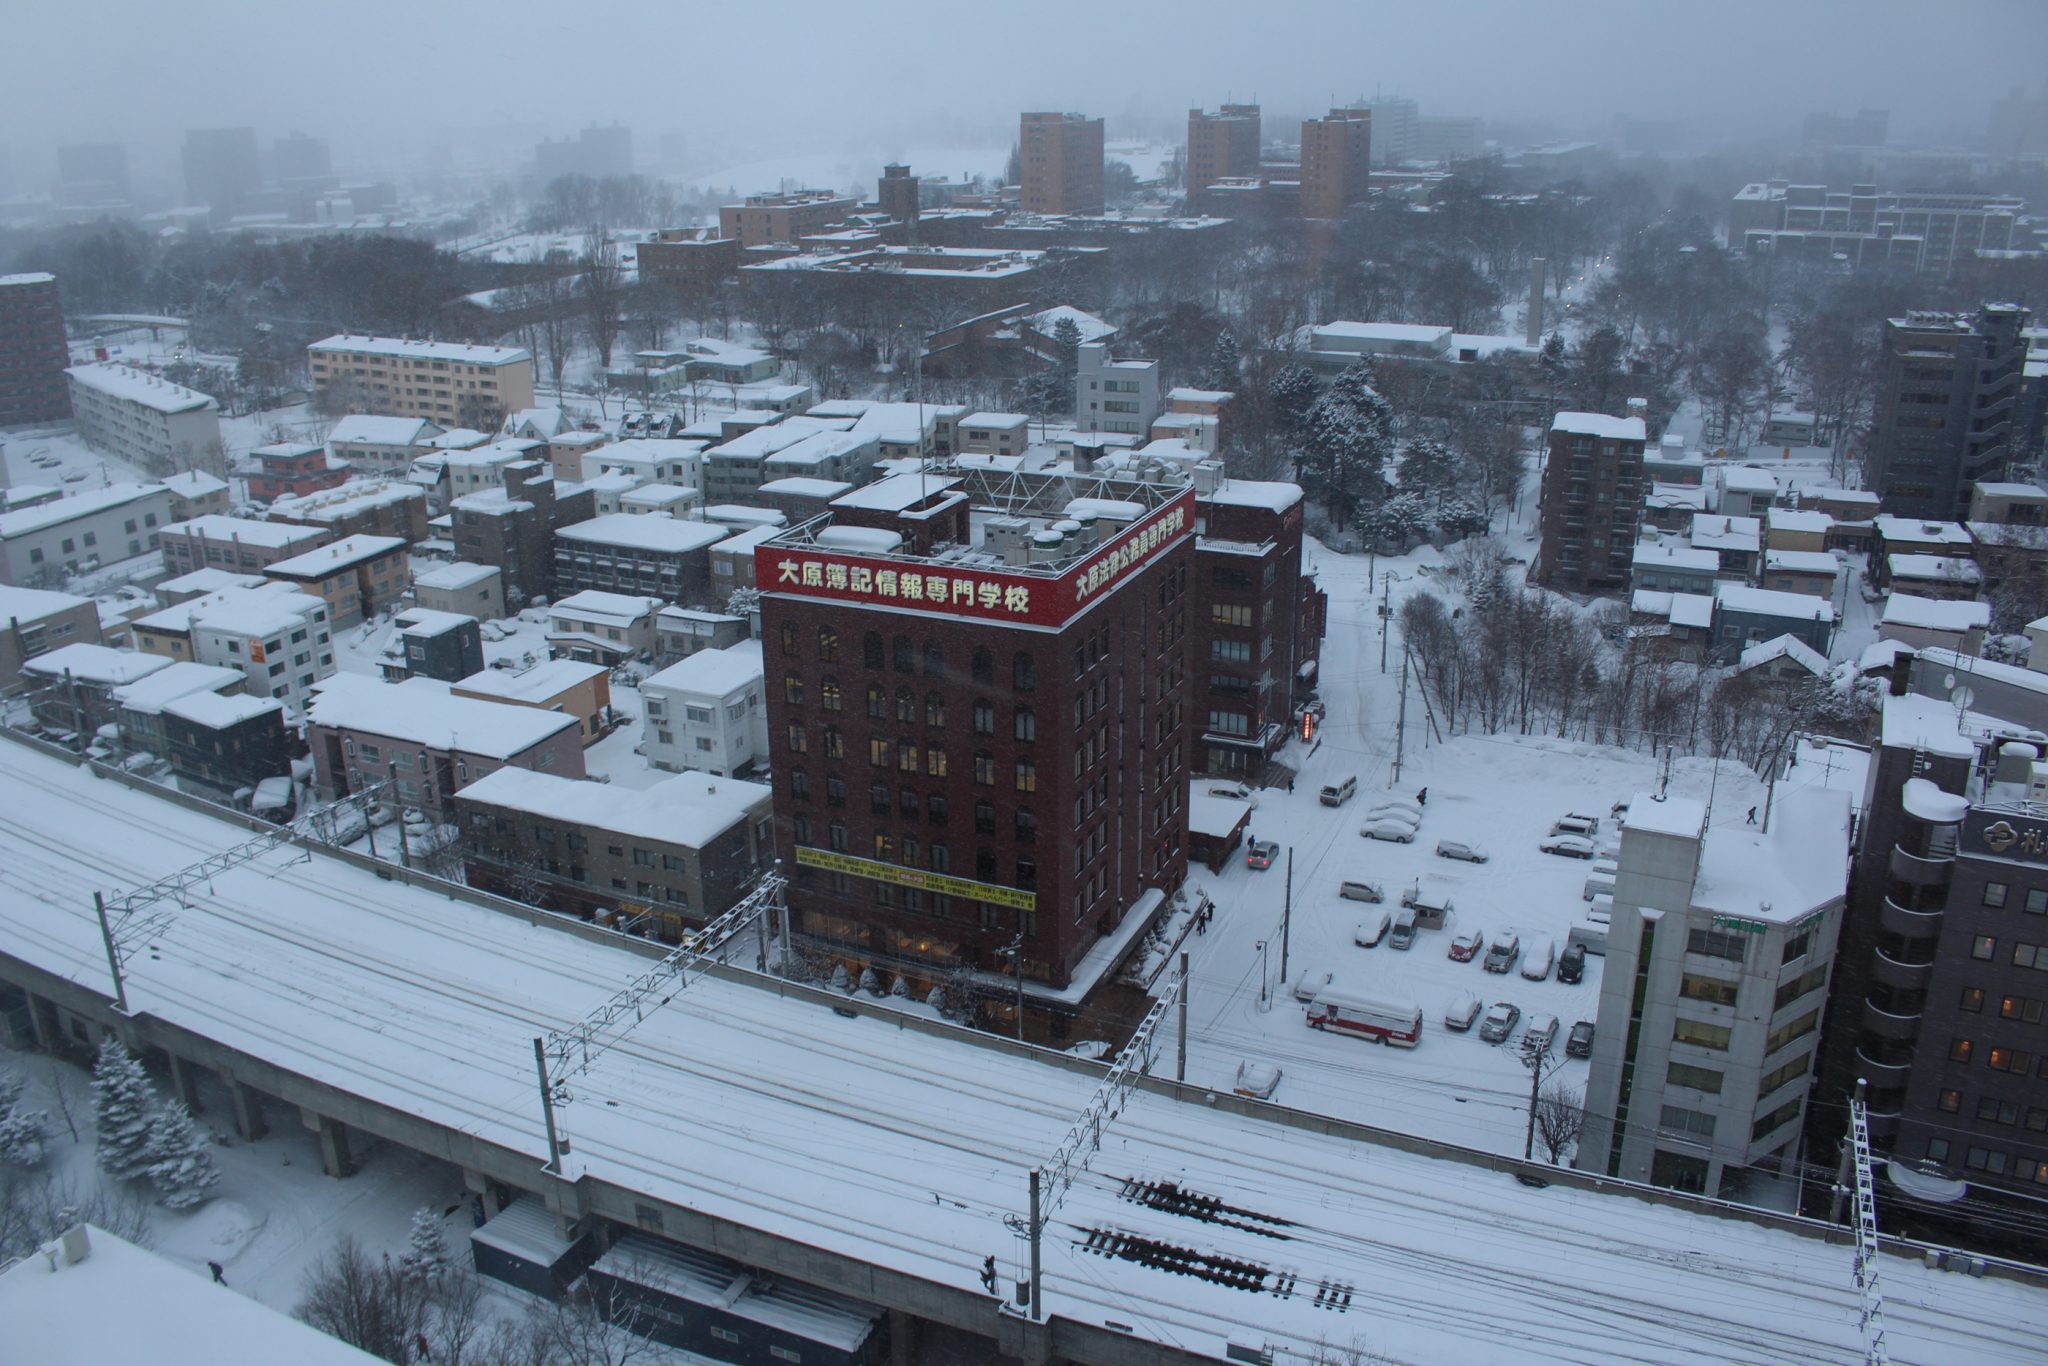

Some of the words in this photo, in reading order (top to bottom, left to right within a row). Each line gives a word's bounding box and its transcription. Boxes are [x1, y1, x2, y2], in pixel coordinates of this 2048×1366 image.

[1075, 505, 1185, 602] 大原法律公務員専門学校
[777, 558, 1030, 614] 大原簿記情報専門学校
[2020, 828, 2048, 856] 札
